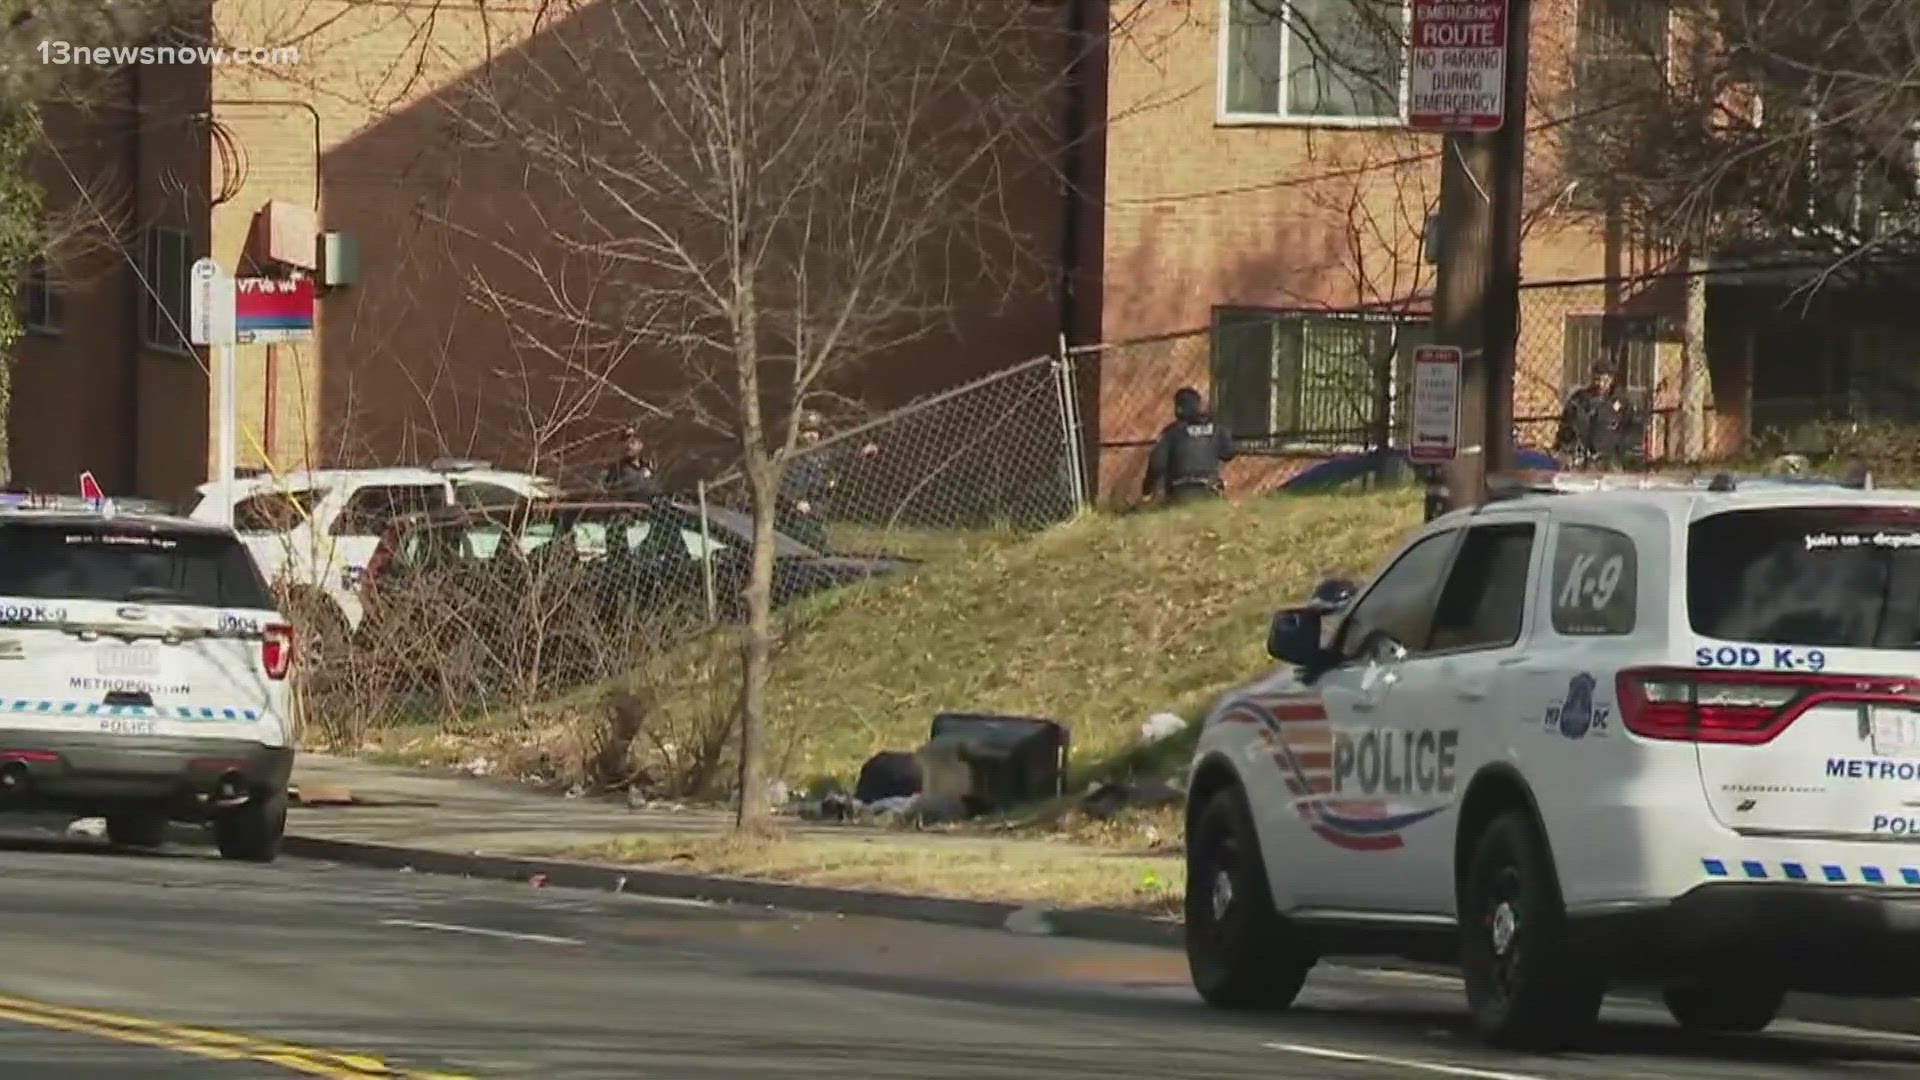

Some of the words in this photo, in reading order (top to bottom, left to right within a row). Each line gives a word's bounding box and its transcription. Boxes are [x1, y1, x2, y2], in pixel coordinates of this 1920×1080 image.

[1416, 4, 1503, 21] EMERGENCY
[1422, 23, 1496, 46] ROUTE
[1415, 50, 1436, 70] NO
[1441, 50, 1499, 70] PARKING
[1432, 71, 1482, 91] DURING
[1414, 93, 1497, 112] EMERGENCY
[1558, 552, 1624, 611] K-9
[1695, 646, 1760, 667] SOD
[1773, 647, 1826, 672] K-9
[69, 676, 191, 695] METROPOLITAN
[1333, 728, 1460, 795] POLICE
[1825, 758, 1920, 781] METRO
